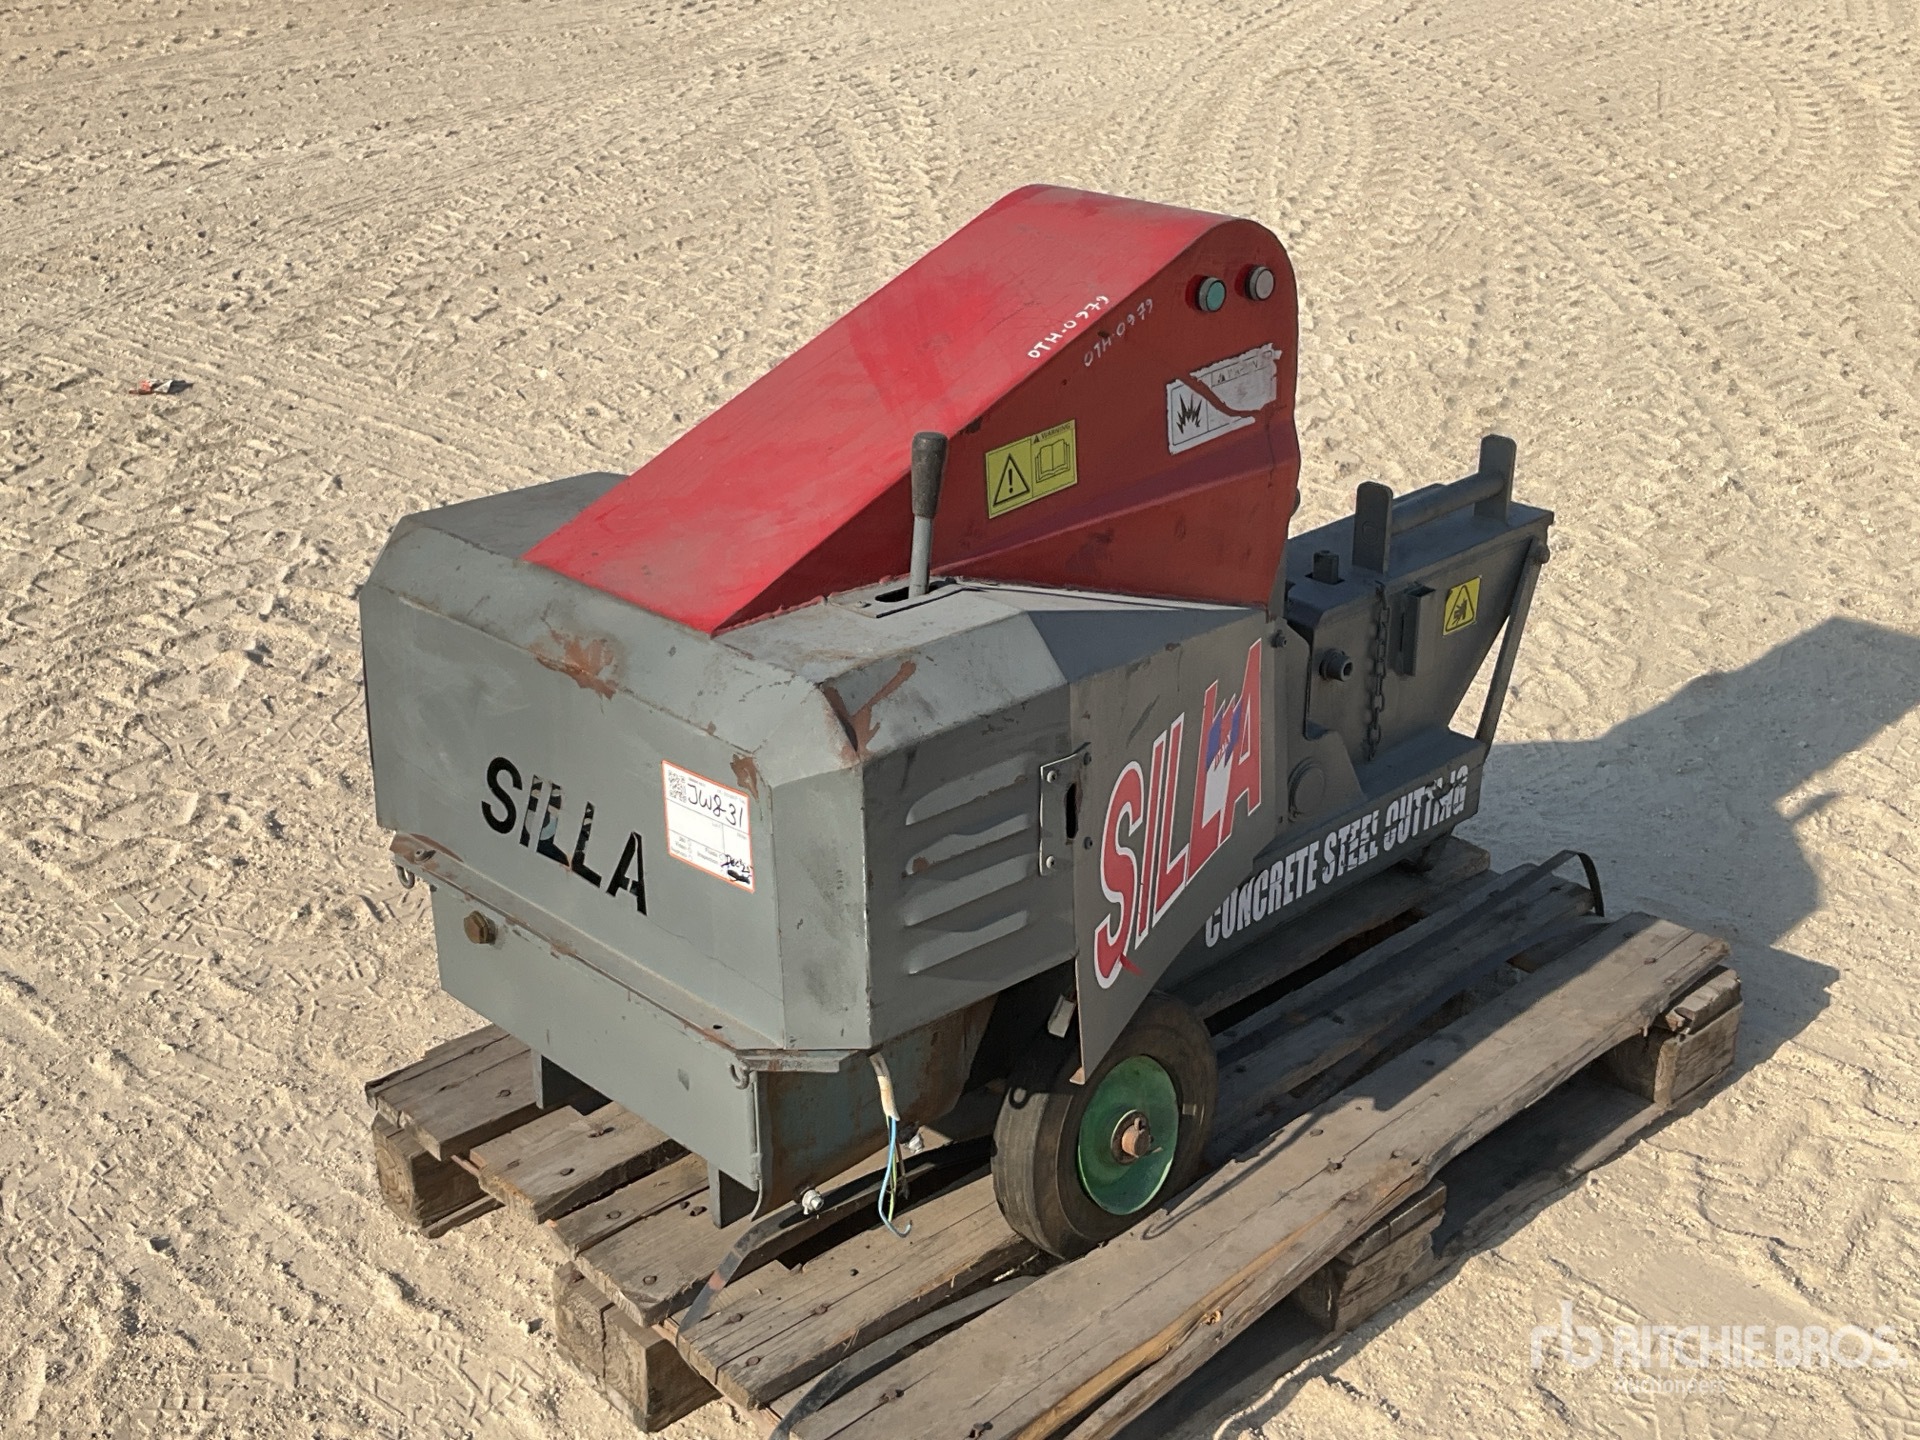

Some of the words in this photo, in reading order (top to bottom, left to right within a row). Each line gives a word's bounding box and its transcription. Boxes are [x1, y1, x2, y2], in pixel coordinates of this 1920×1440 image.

[1041, 423, 1071, 440] WARNING
[481, 756, 648, 917] SILLA
[1094, 638, 1262, 989] SILLA
[1205, 839, 1320, 948] CONCRETE
[1321, 809, 1380, 885] STEEL
